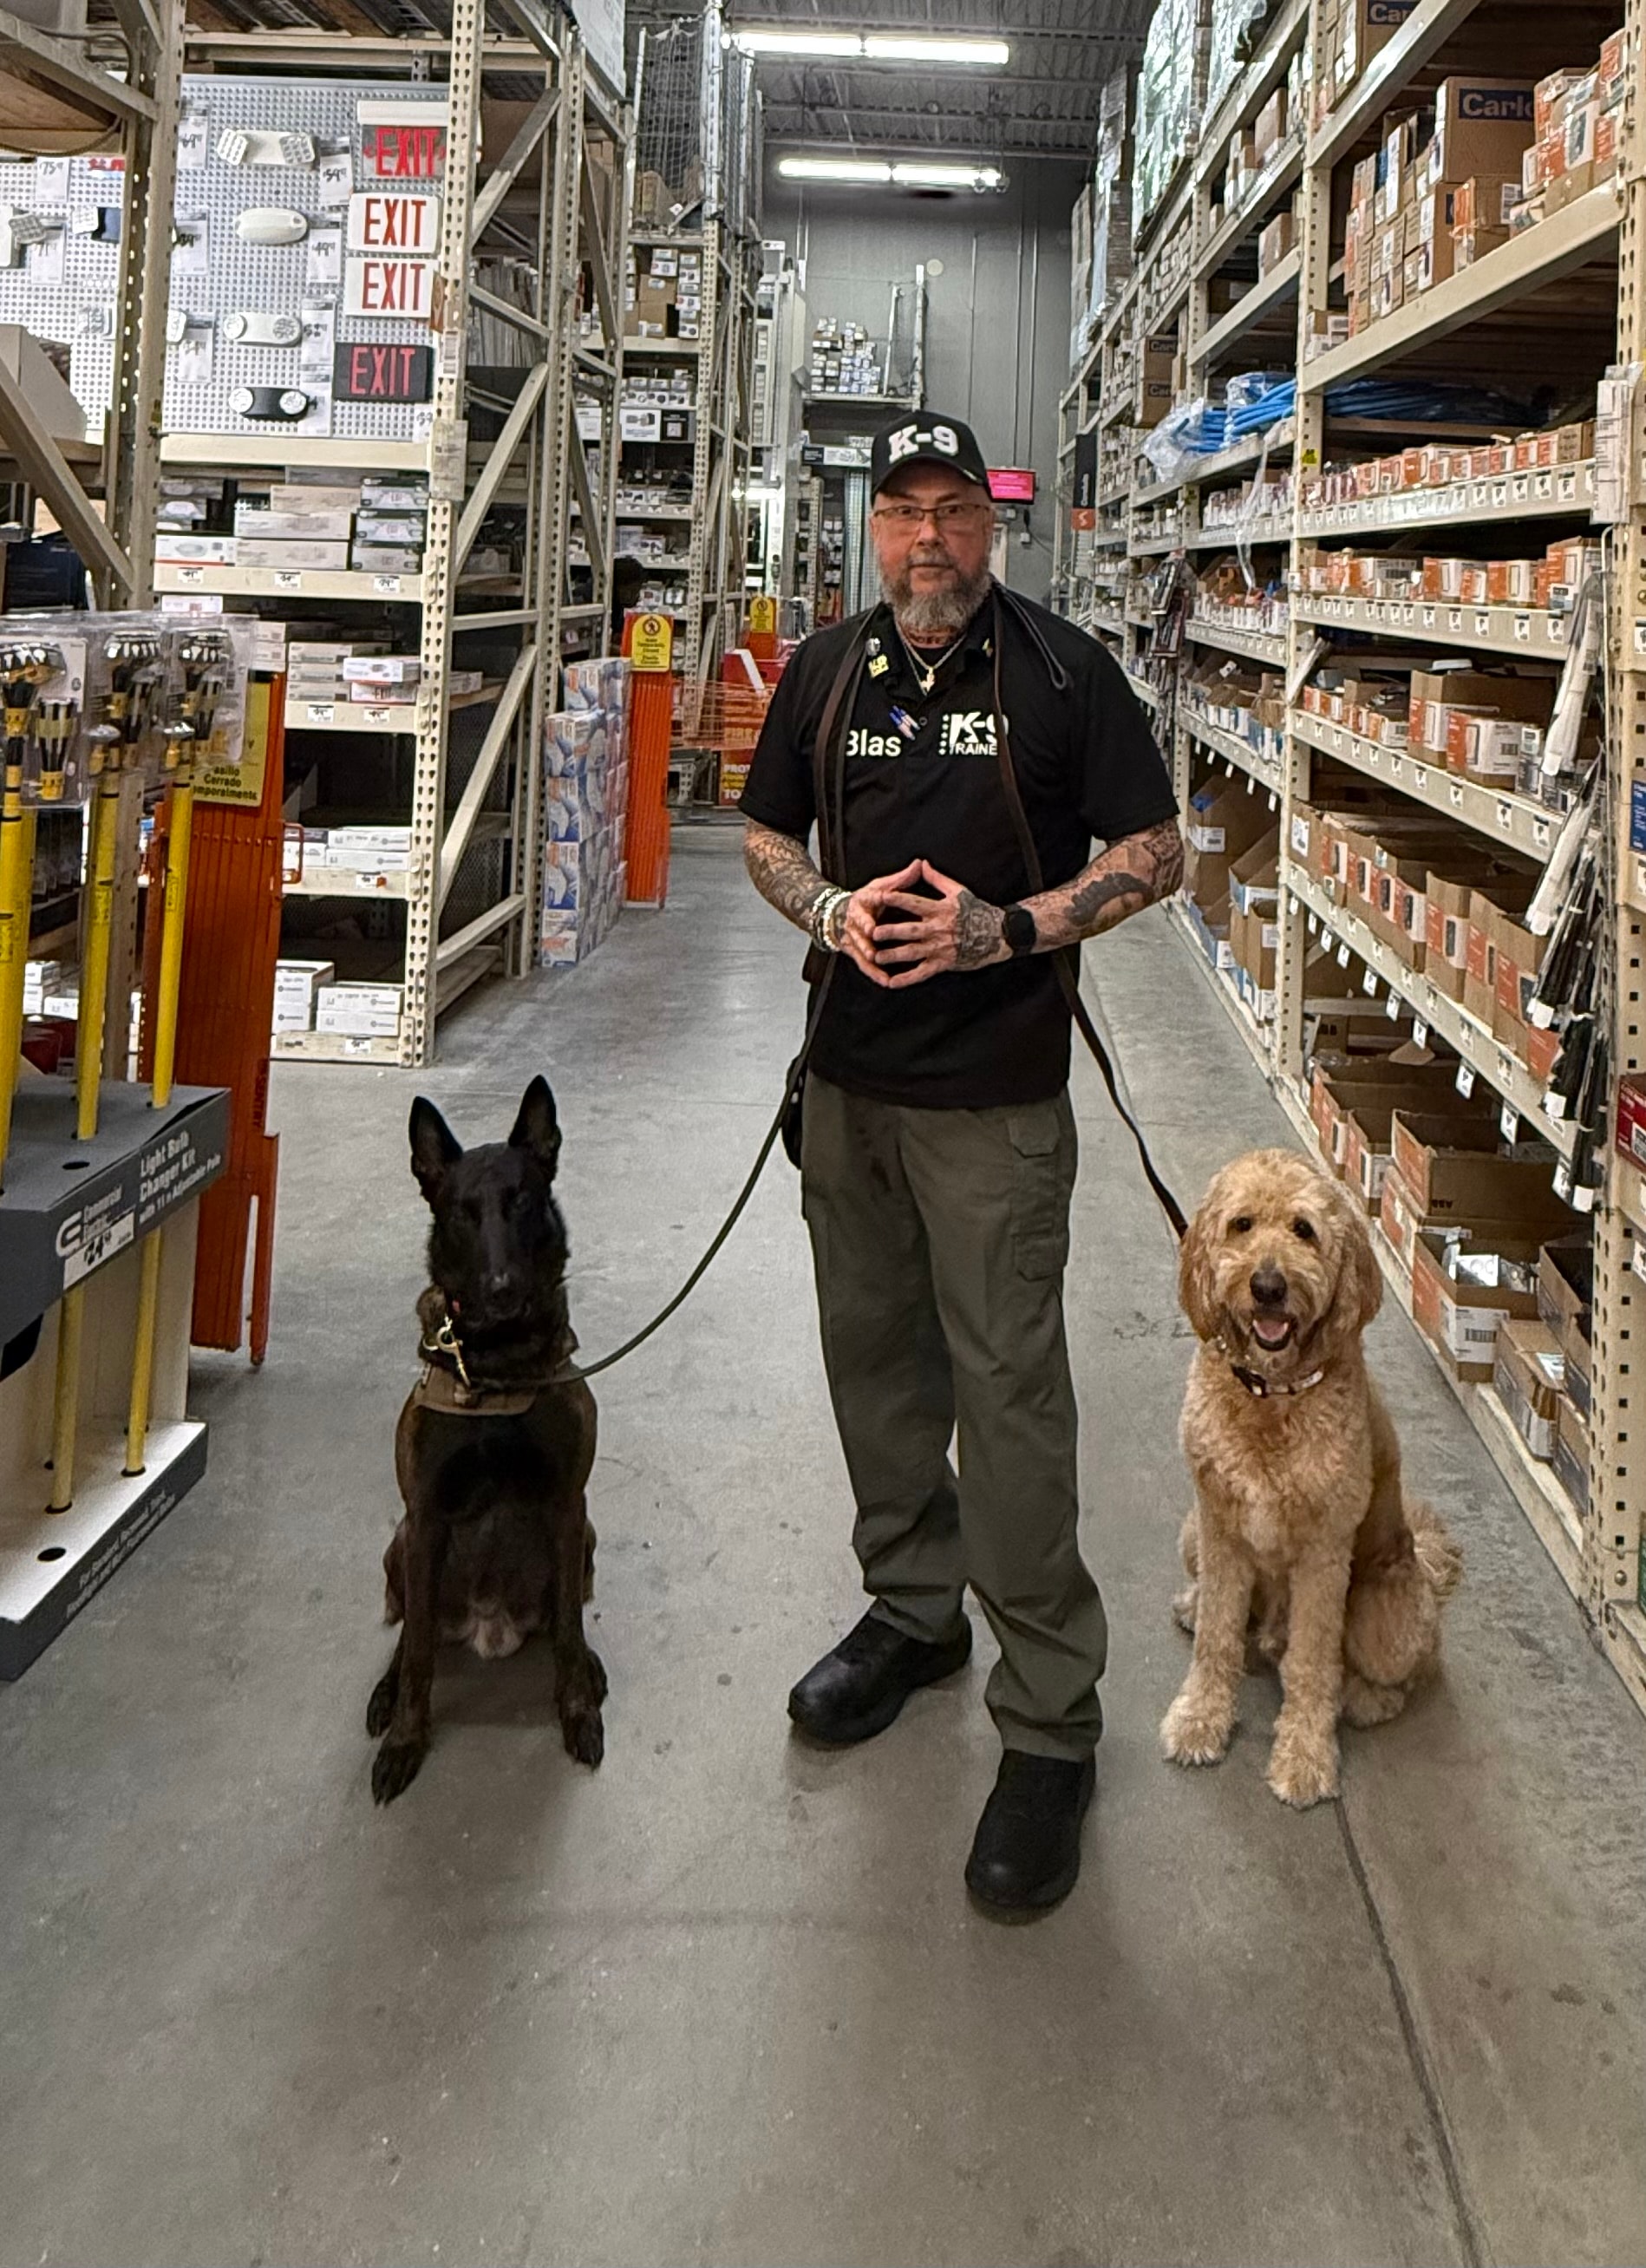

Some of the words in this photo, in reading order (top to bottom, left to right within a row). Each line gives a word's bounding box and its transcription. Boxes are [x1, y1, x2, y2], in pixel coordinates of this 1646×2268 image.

[376, 127, 440, 177] EXIT
[363, 198, 427, 247] EXIT
[362, 262, 426, 311] EXIT
[349, 346, 416, 396] EXIT
[888, 423, 959, 464] K-9
[846, 729, 902, 757] Blas
[950, 710, 1009, 748] K-9
[950, 742, 997, 756] TRAINE
[204, 774, 242, 788] Cerrado
[213, 766, 240, 776] asillo
[140, 1145, 166, 1178] Light
[167, 1130, 189, 1159] Bulb
[140, 1161, 180, 1202] Changer
[182, 1147, 196, 1172] Kit
